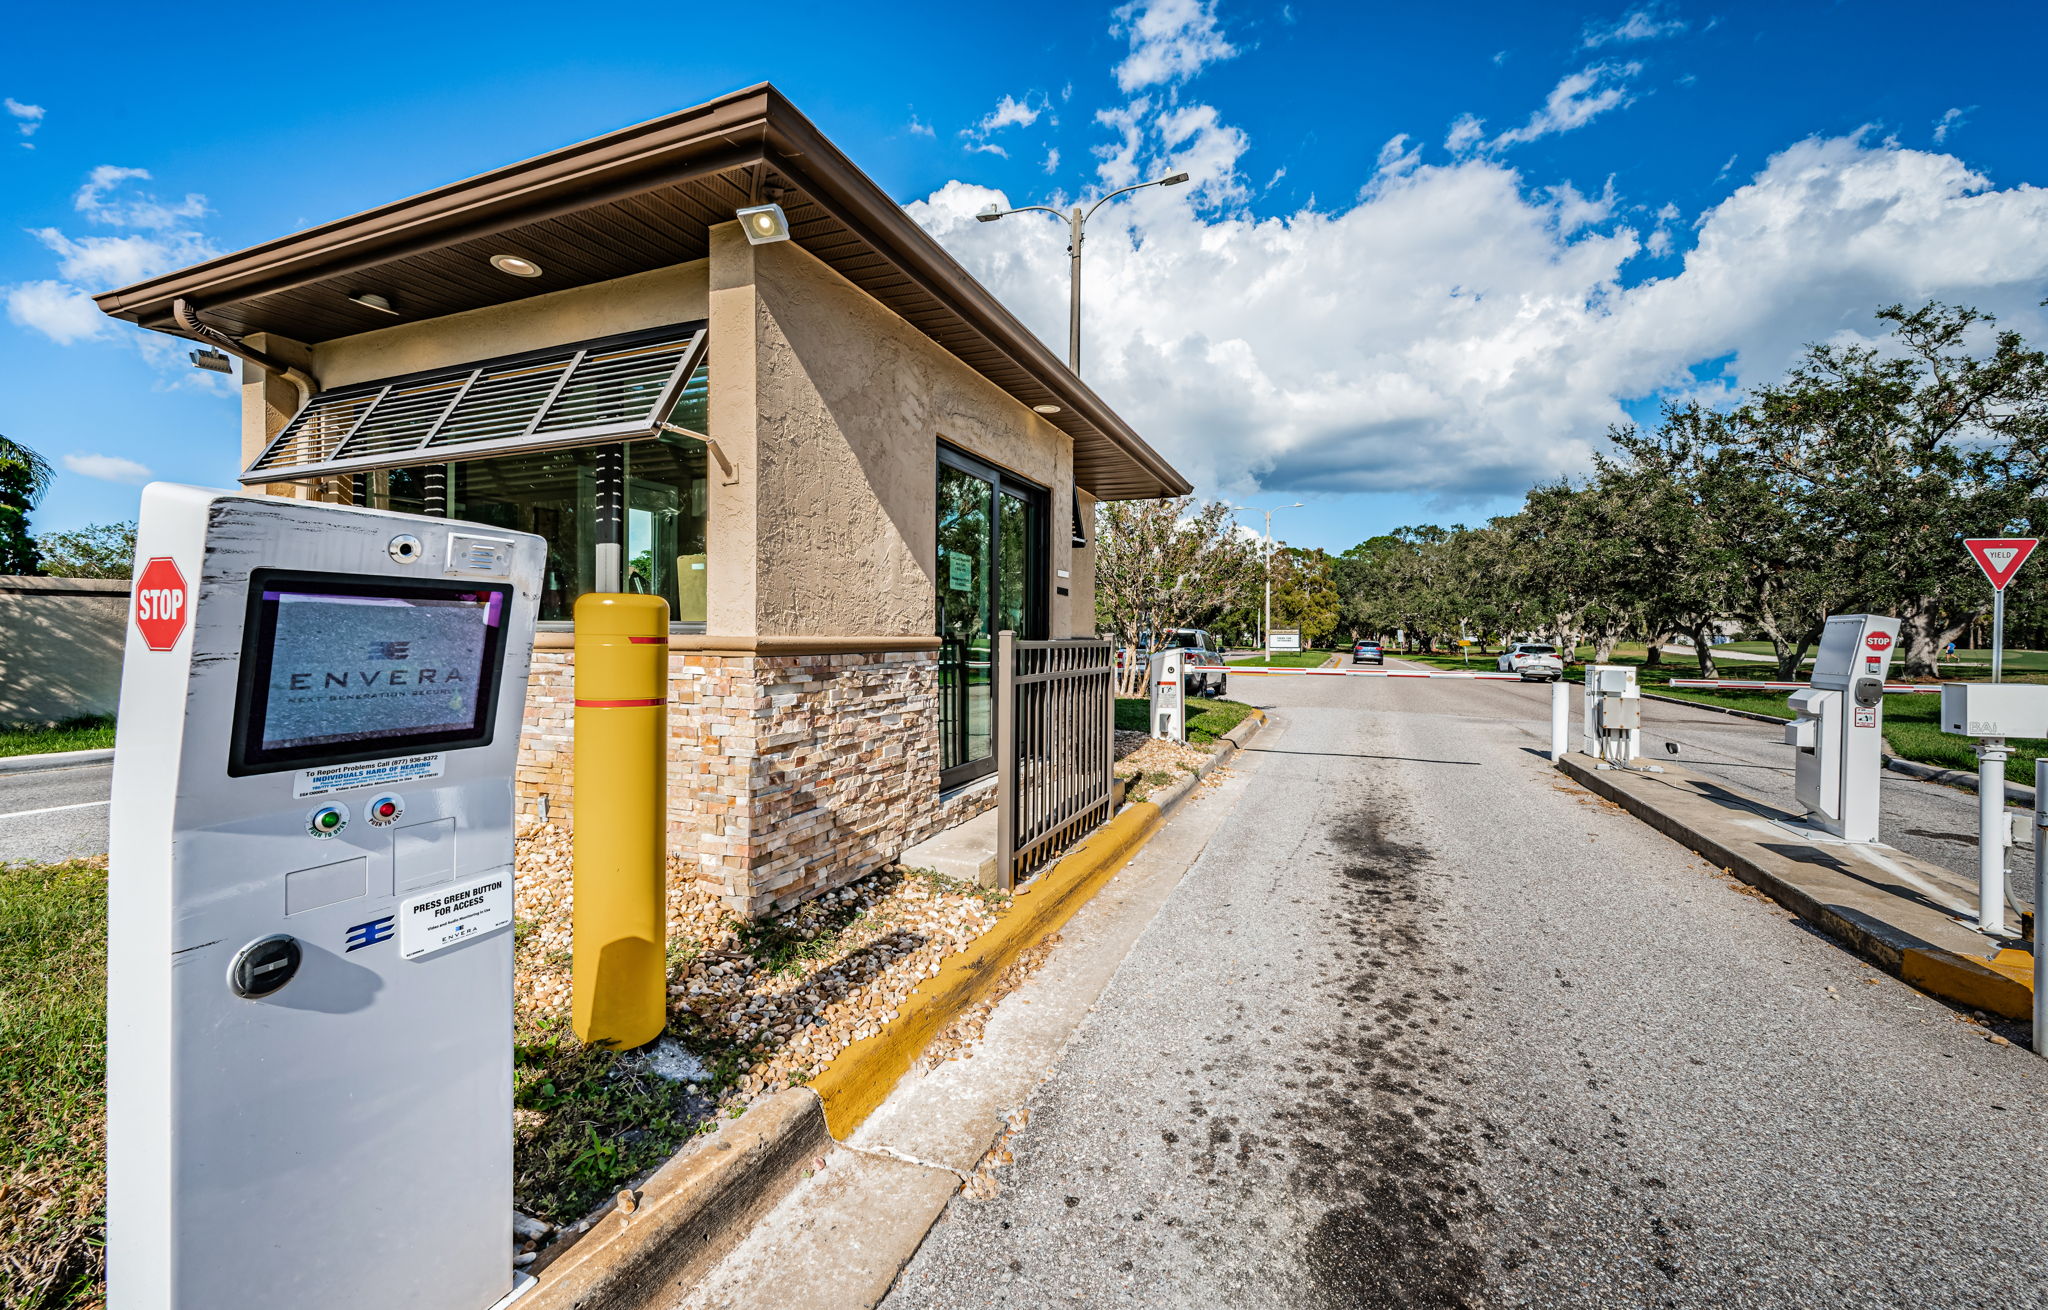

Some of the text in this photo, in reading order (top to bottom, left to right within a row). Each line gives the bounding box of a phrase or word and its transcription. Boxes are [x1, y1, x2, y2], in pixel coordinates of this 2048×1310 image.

[140, 589, 183, 620] STOP
[289, 668, 463, 690] ENVERA
[288, 696, 321, 704] NEXT
[329, 691, 405, 701] GENERATION
[313, 771, 363, 782] INDIVIDUALS
[401, 762, 431, 770] HEARING
[317, 768, 341, 776] Report
[344, 764, 375, 772] Problems
[410, 755, 438, 763] 936-8372
[368, 818, 381, 826] PUSH
[393, 810, 403, 821] CALL
[308, 826, 322, 838] PUSH
[334, 821, 346, 834] OPEN
[414, 881, 502, 914] PRESS GREEN BUTTON
[435, 896, 484, 917] FOR ACCESS
[460, 912, 479, 920] Monitoring
[442, 927, 477, 942] ENVERA
